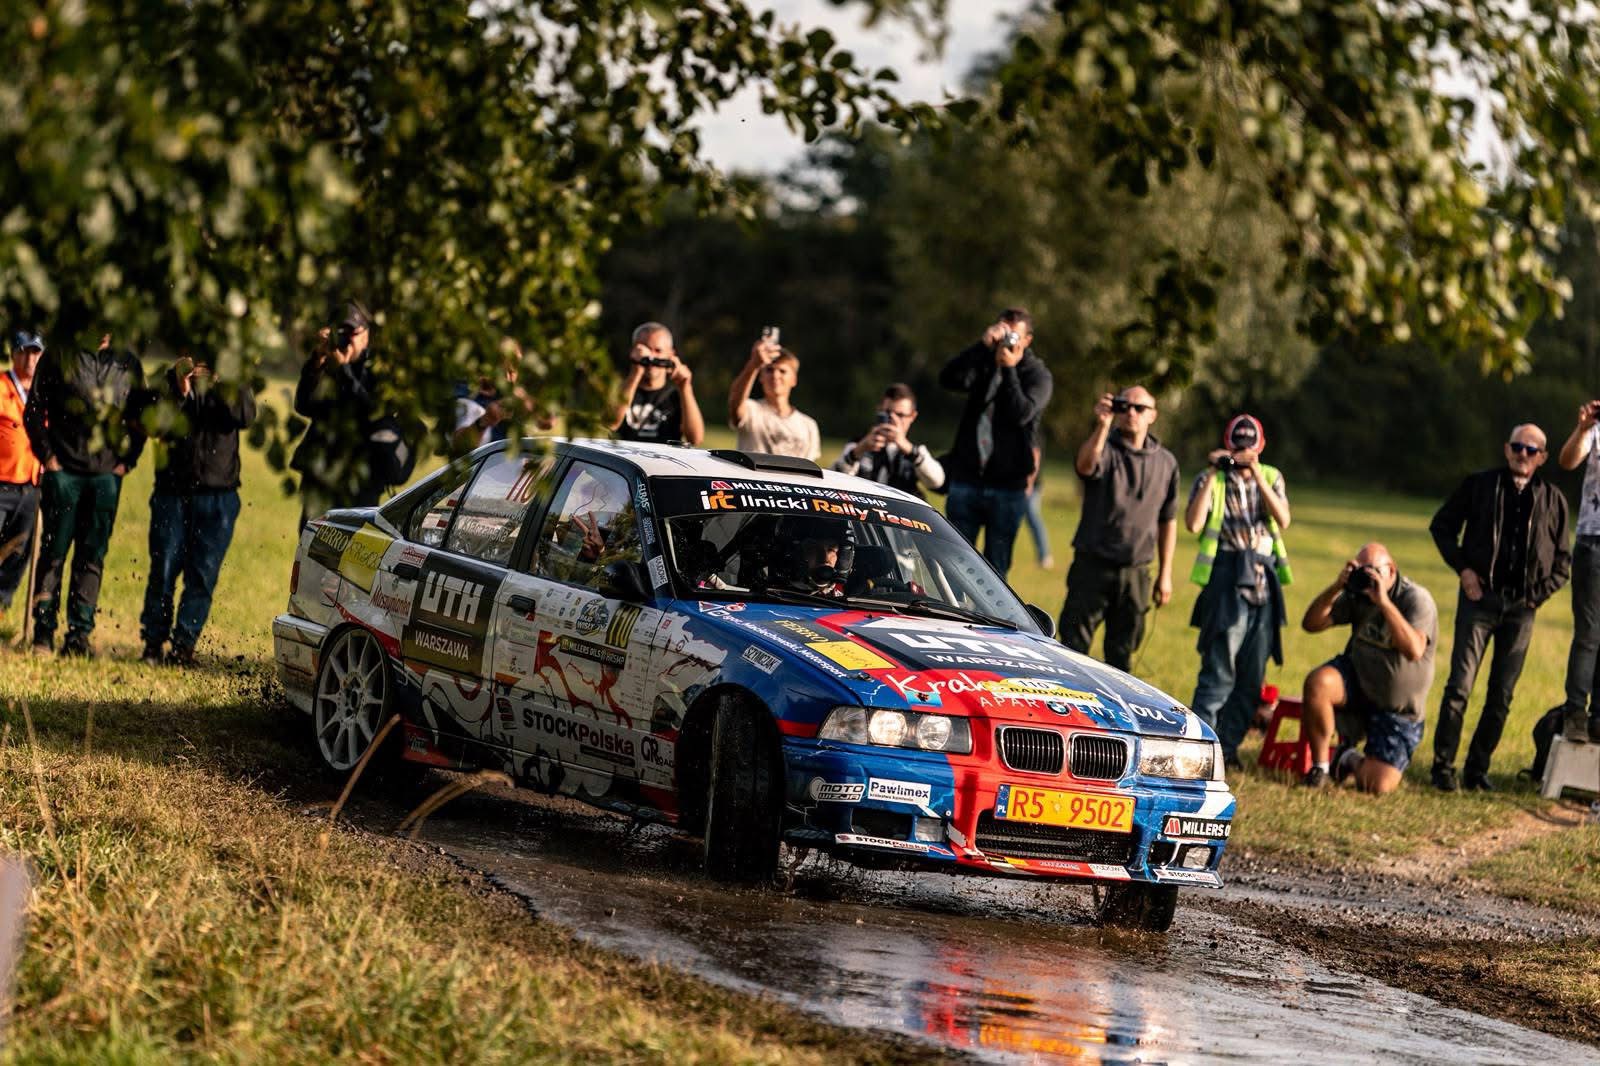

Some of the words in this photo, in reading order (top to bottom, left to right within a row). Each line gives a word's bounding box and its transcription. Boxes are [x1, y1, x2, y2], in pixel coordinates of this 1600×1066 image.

[731, 482, 792, 493] MILLERS
[795, 488, 823, 498] OILS
[741, 494, 808, 511] Ilnicki
[812, 498, 869, 521] Rally
[872, 508, 932, 534] Team
[317, 523, 348, 552] FERRO
[420, 570, 484, 624] UTH
[608, 608, 640, 648] 110
[773, 620, 829, 643] FERRO
[415, 630, 469, 661] WARSZAWA
[744, 646, 778, 671] SZYMCZAK
[888, 632, 1053, 664] UTH
[926, 654, 1077, 677] WARSZAWA
[1018, 680, 1049, 690] 110
[522, 708, 634, 756] STOCKPolska
[871, 782, 929, 799] Pawlimex
[997, 805, 1007, 813] PL
[1012, 789, 1045, 820] R5
[1069, 796, 1127, 828] 9502
[1182, 821, 1224, 836] MILLERS
